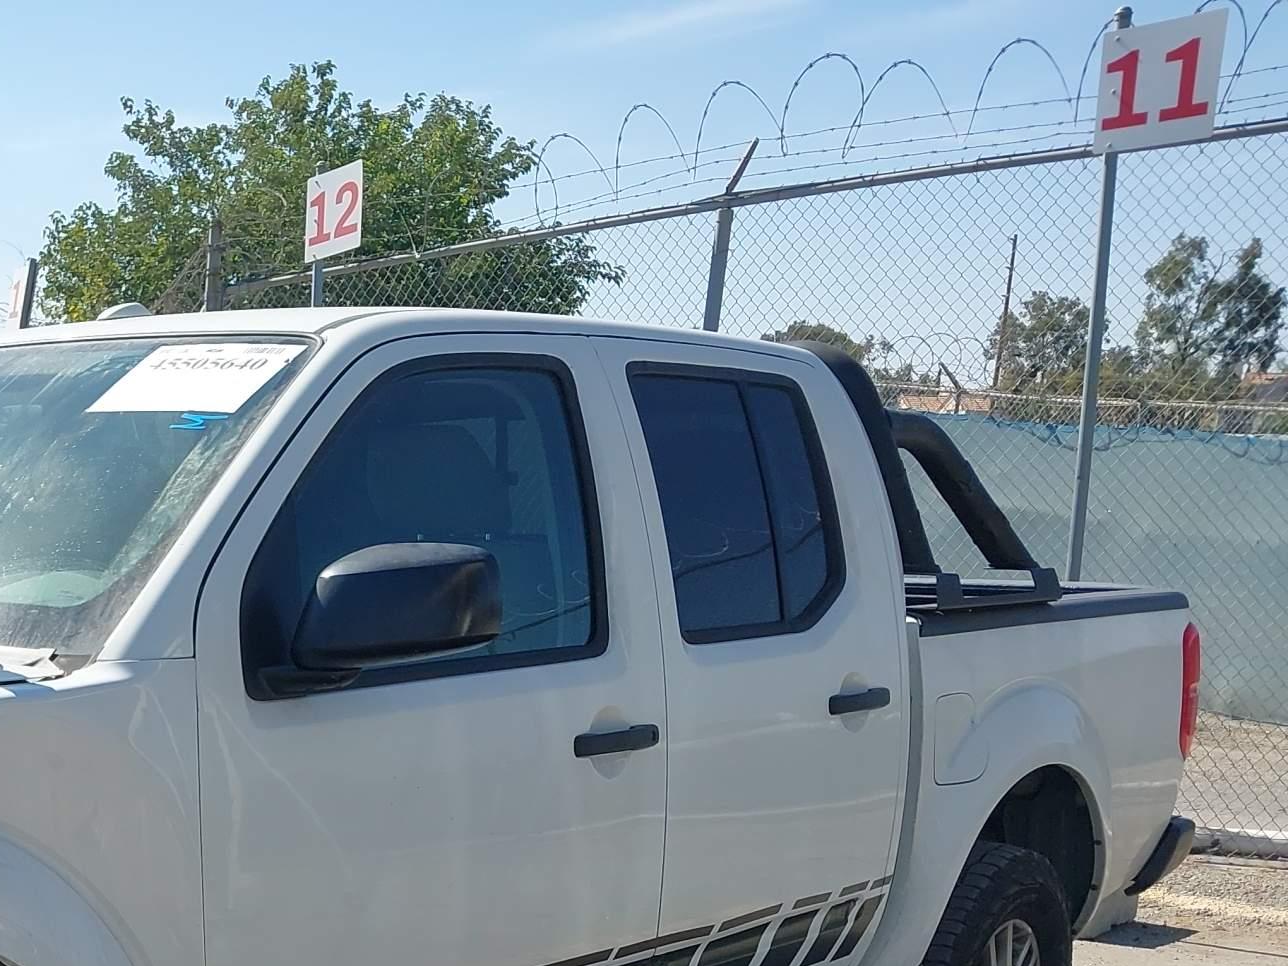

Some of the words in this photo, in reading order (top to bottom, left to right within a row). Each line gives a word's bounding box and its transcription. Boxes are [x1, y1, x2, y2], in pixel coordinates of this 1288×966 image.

[1101, 36, 1210, 132] 11
[308, 181, 359, 247] 12
[149, 357, 270, 371] 45505640
